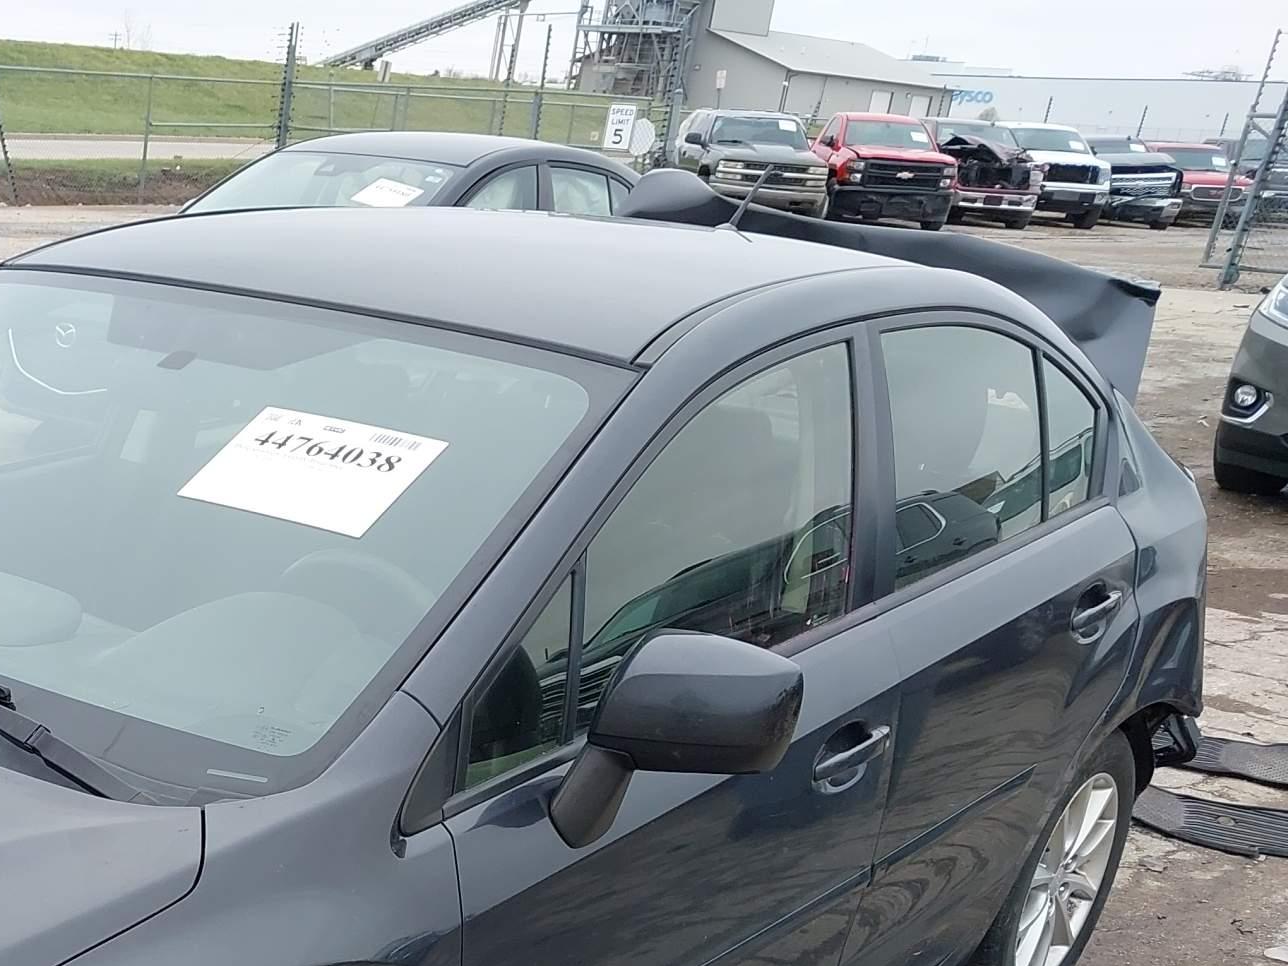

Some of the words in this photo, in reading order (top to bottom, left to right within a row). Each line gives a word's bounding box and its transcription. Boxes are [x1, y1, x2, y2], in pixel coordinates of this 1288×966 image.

[611, 108, 634, 116] SPEED
[611, 118, 631, 126] LIMIT
[611, 129, 624, 144] 5
[254, 430, 402, 473] 44764038
